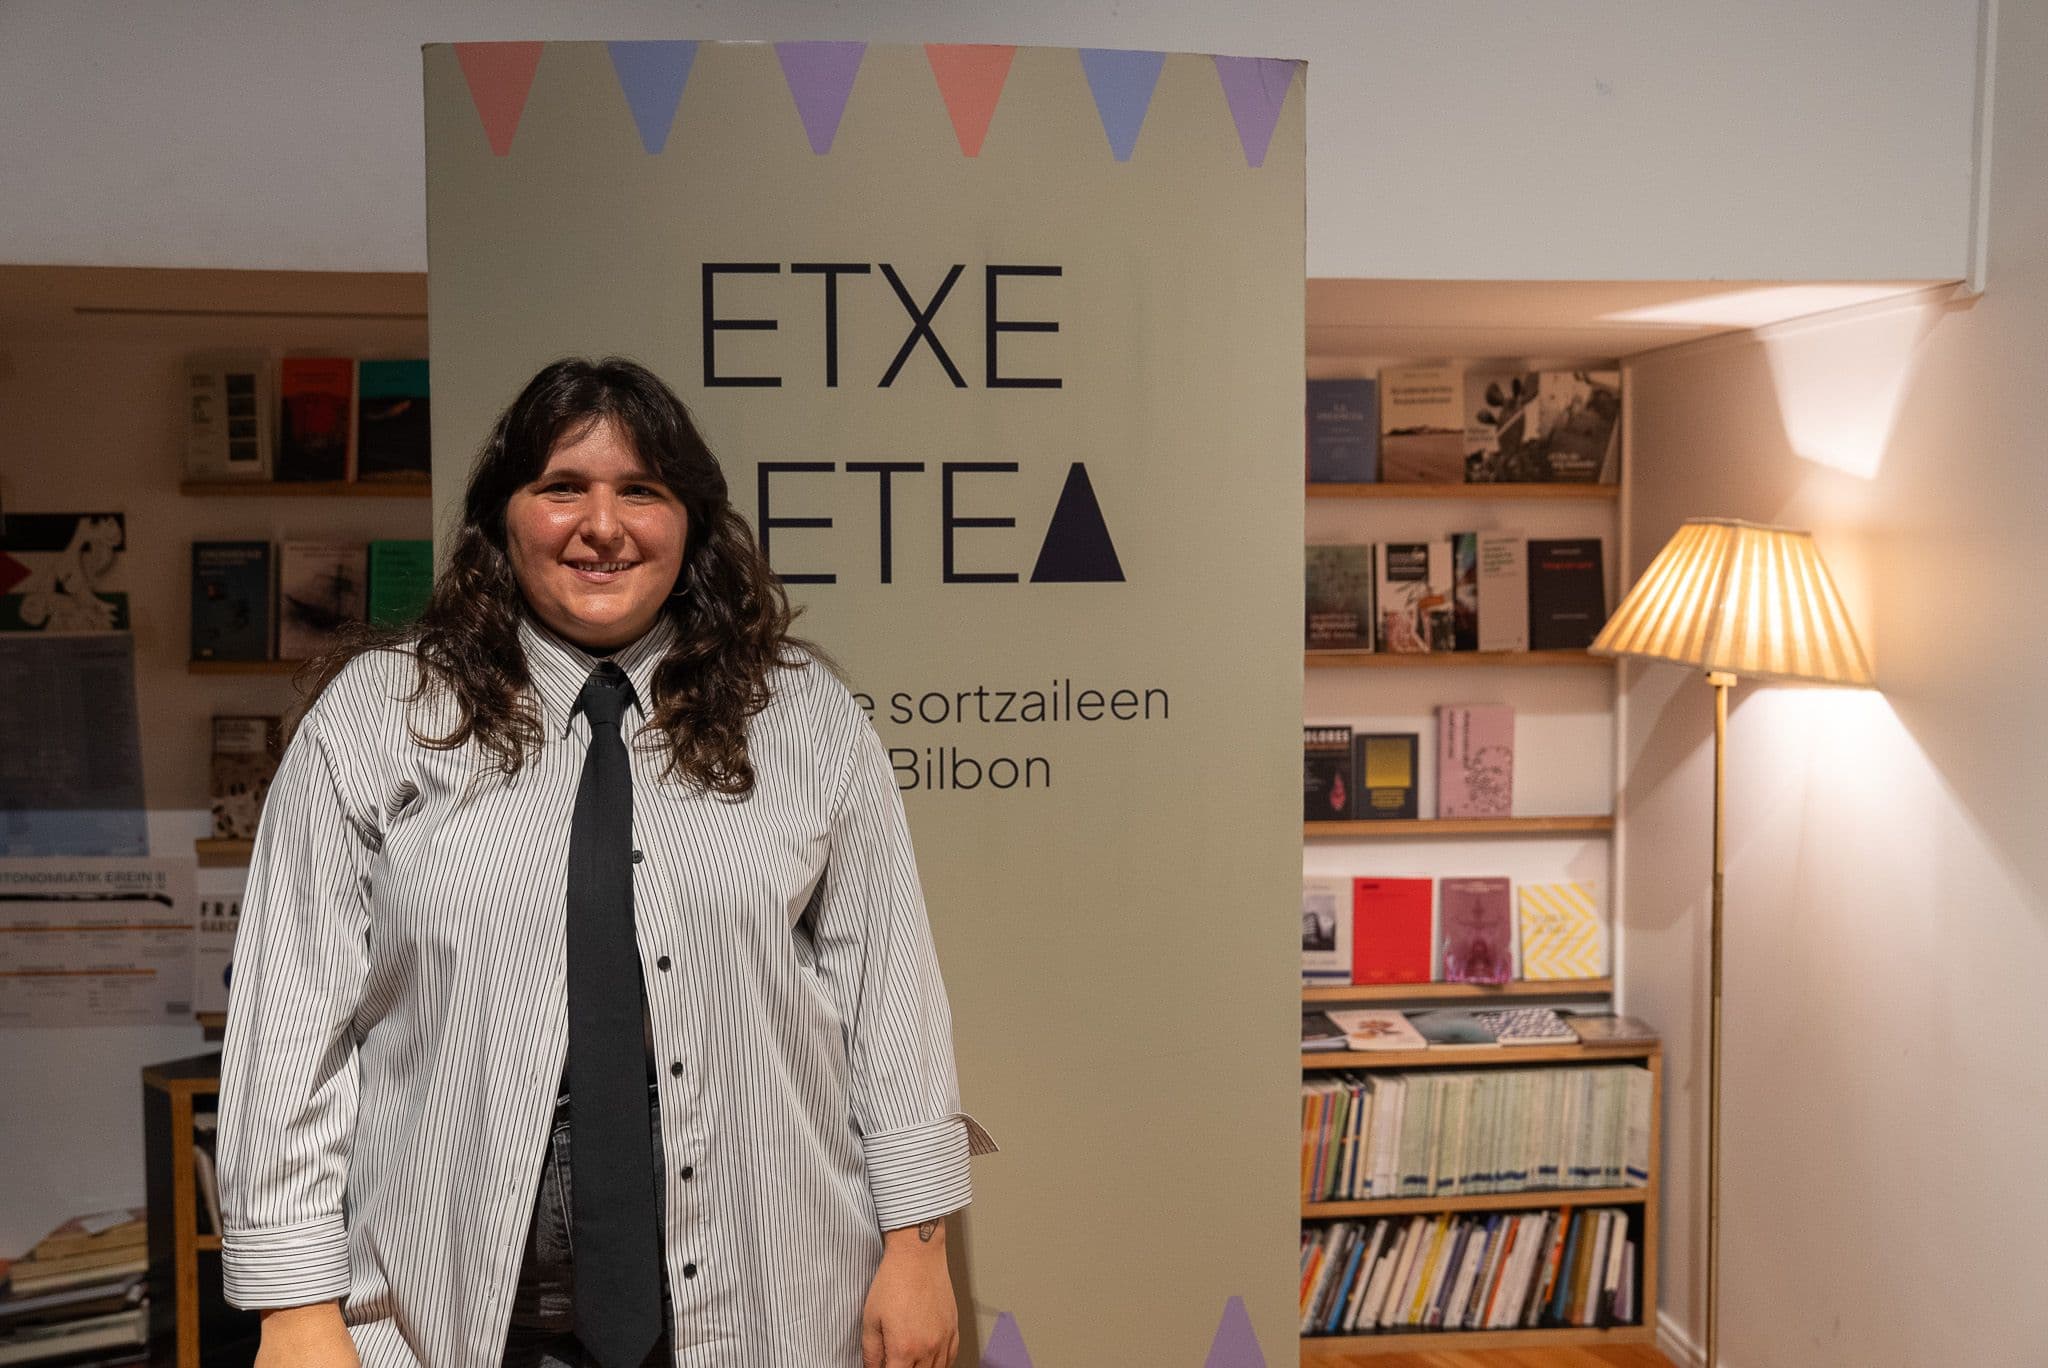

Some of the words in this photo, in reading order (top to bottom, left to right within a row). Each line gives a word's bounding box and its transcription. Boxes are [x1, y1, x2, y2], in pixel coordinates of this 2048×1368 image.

[702, 263, 1063, 388] ETXE
[757, 461, 1127, 584] ETEA
[890, 678, 1169, 724] sortzaileen
[888, 747, 1051, 790] Bilbon
